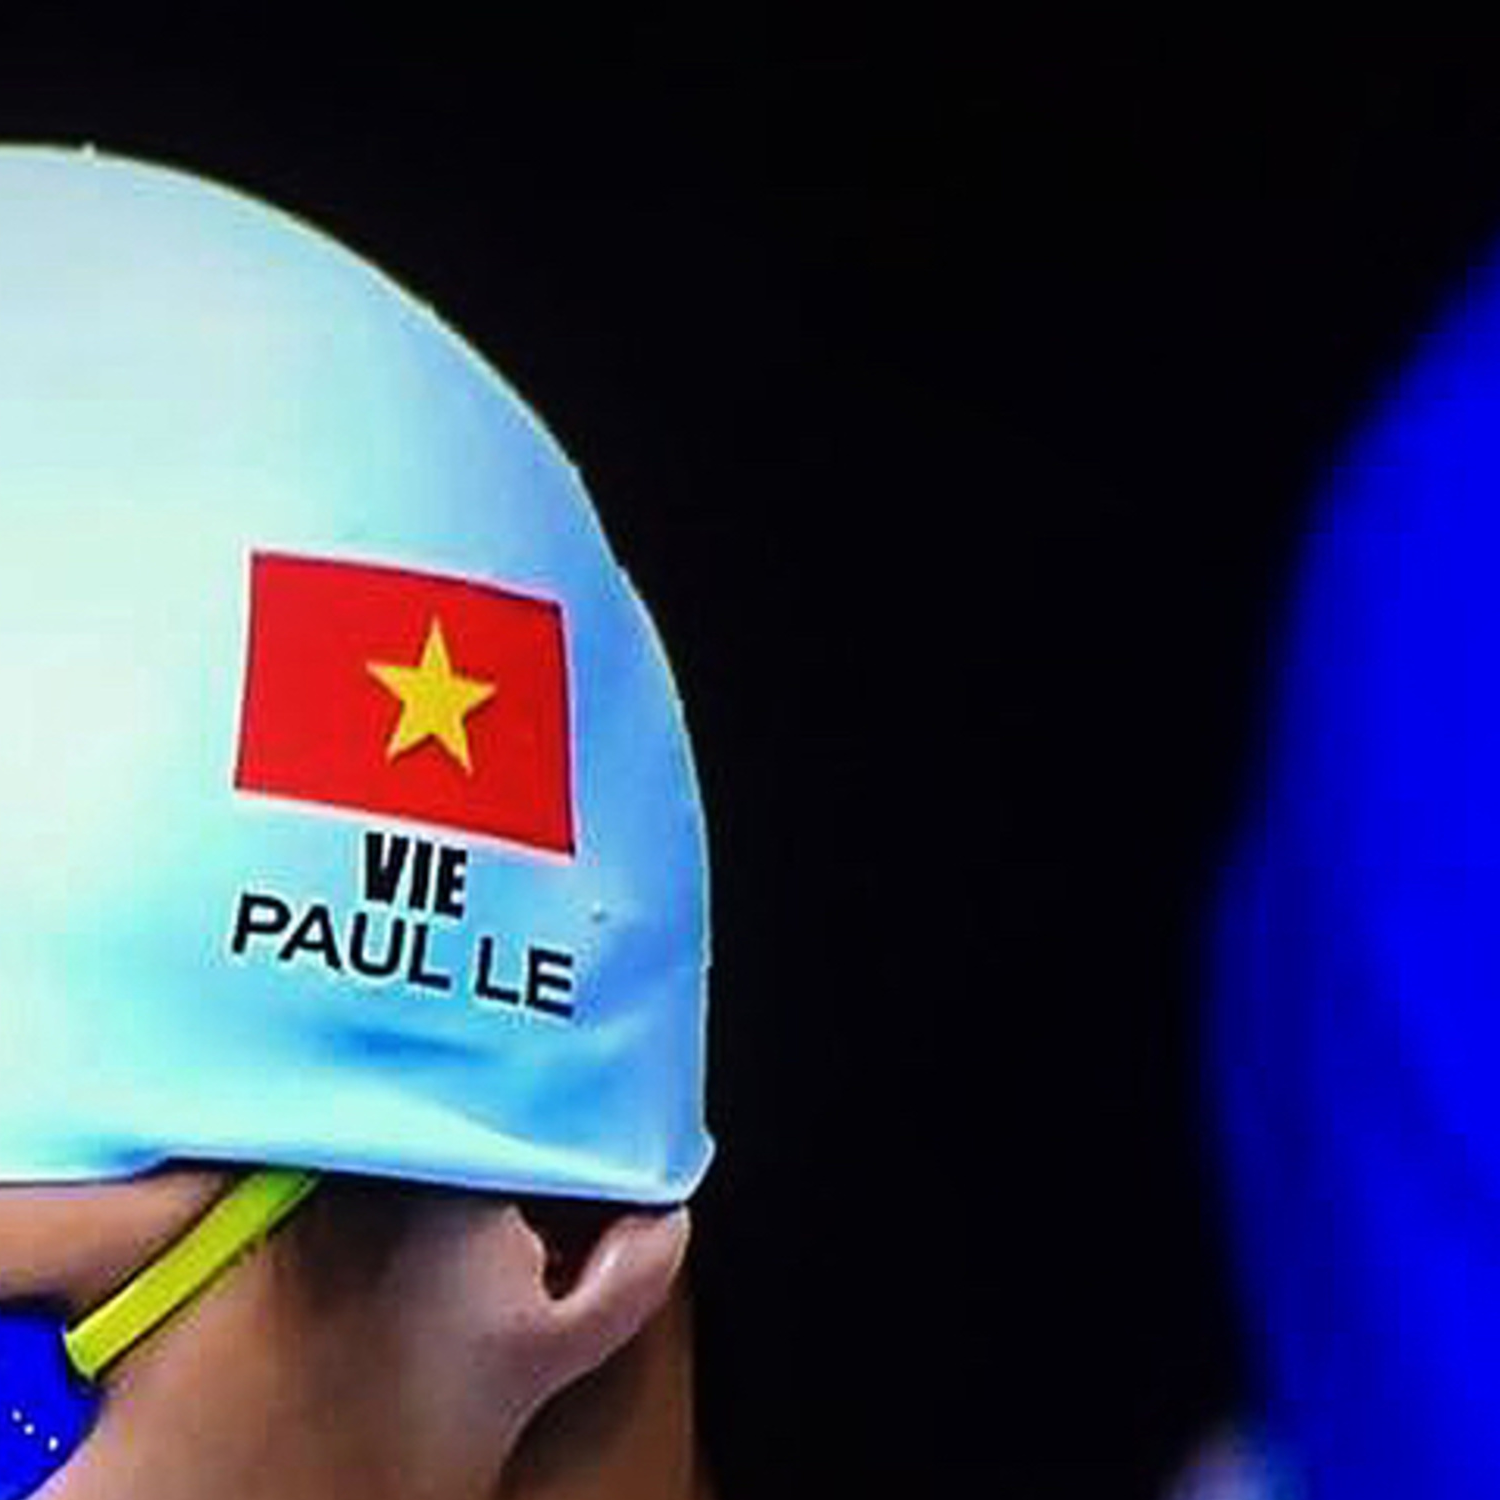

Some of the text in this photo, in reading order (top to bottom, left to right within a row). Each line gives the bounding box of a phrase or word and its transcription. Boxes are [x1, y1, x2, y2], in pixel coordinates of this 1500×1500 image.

[363, 830, 469, 921] VIE
[231, 892, 577, 1021] PAUL LE
